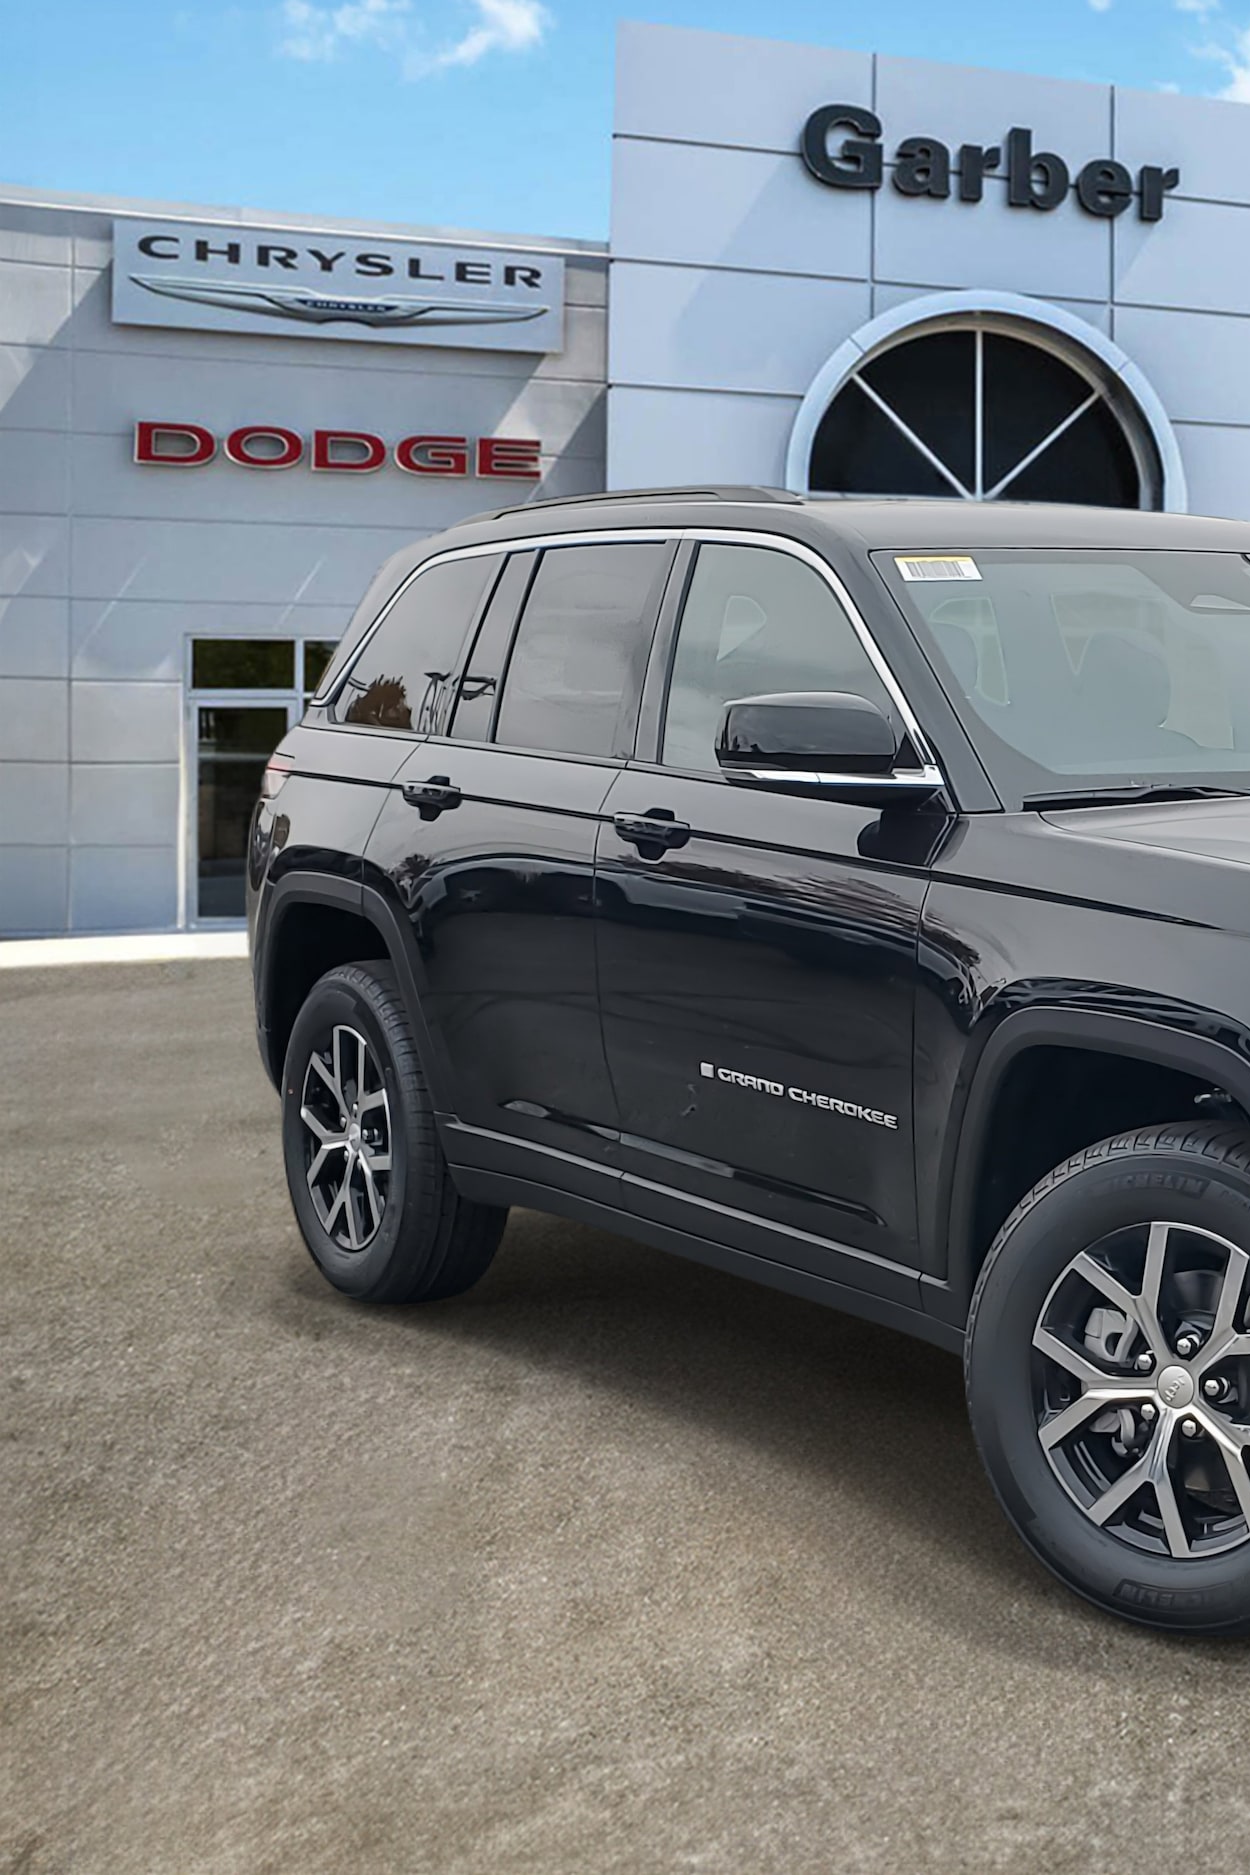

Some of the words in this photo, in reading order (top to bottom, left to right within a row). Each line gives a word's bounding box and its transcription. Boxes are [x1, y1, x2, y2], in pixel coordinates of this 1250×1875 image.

[802, 103, 1180, 222] Garber
[137, 235, 543, 289] CHRYSLER
[133, 421, 543, 481] DODGE
[717, 1067, 784, 1097] GRAND
[788, 1087, 898, 1130] CHEROKEE
